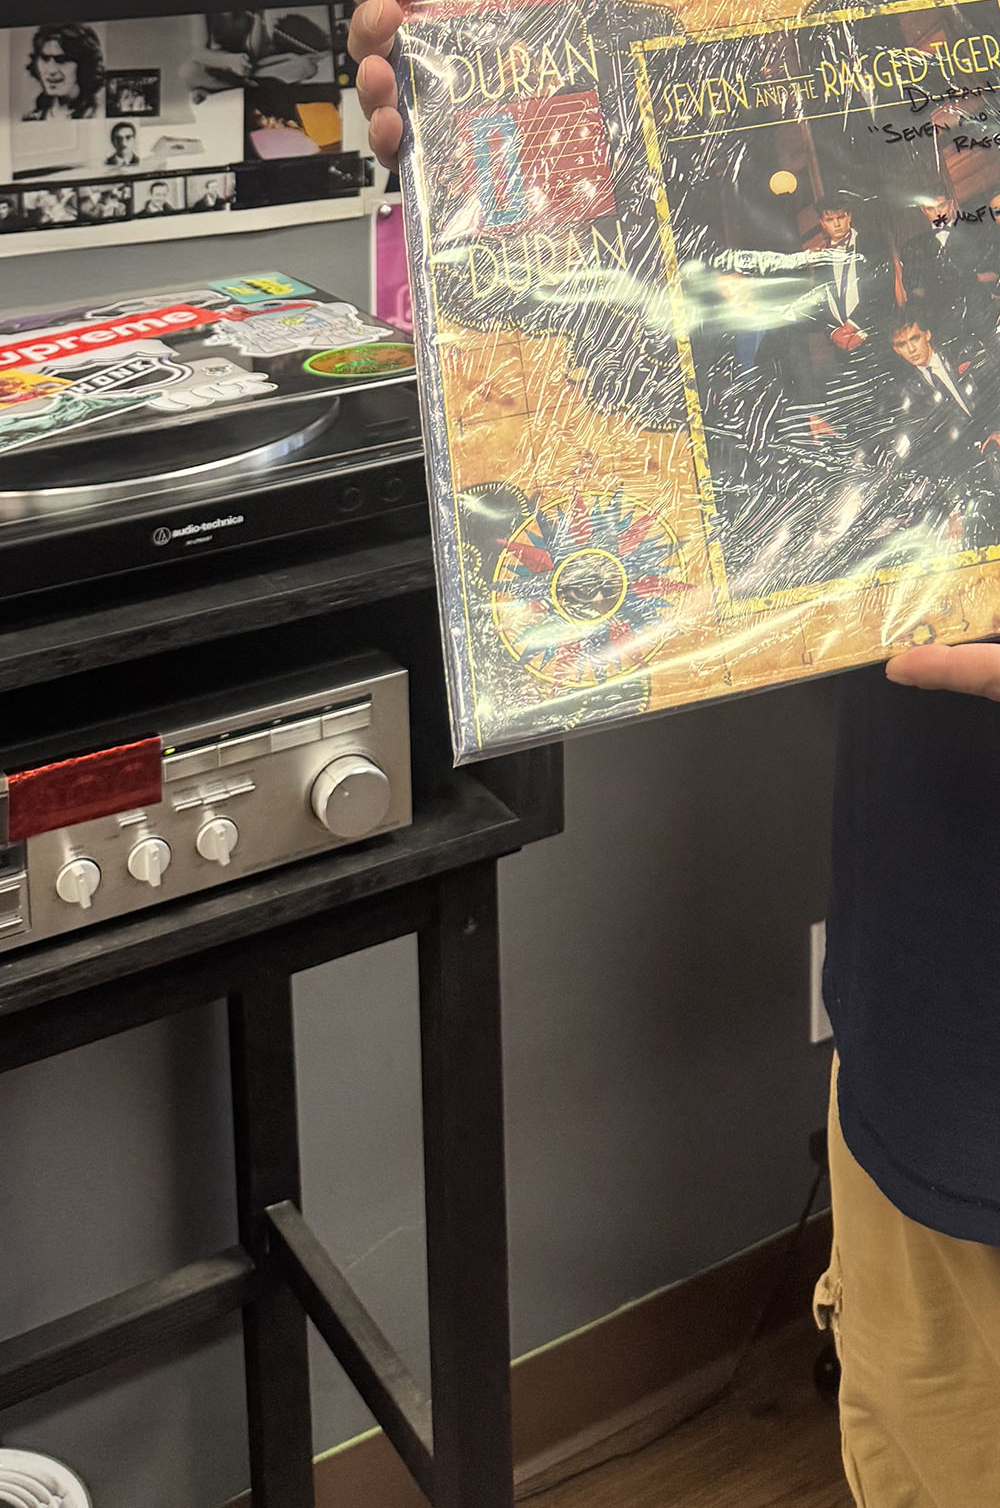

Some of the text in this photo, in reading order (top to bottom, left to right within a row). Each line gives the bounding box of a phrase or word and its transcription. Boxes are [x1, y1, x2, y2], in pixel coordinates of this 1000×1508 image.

[447, 34, 600, 105] DURAN
[663, 74, 750, 124] SEVEN
[755, 86, 790, 108] AND
[790, 79, 819, 102] THE
[816, 46, 928, 100] RAGGED
[902, 80, 997, 113] DURAN
[468, 220, 628, 300] DURAN
[69, 358, 154, 394] HONK
[172, 515, 245, 539] audio-technica
